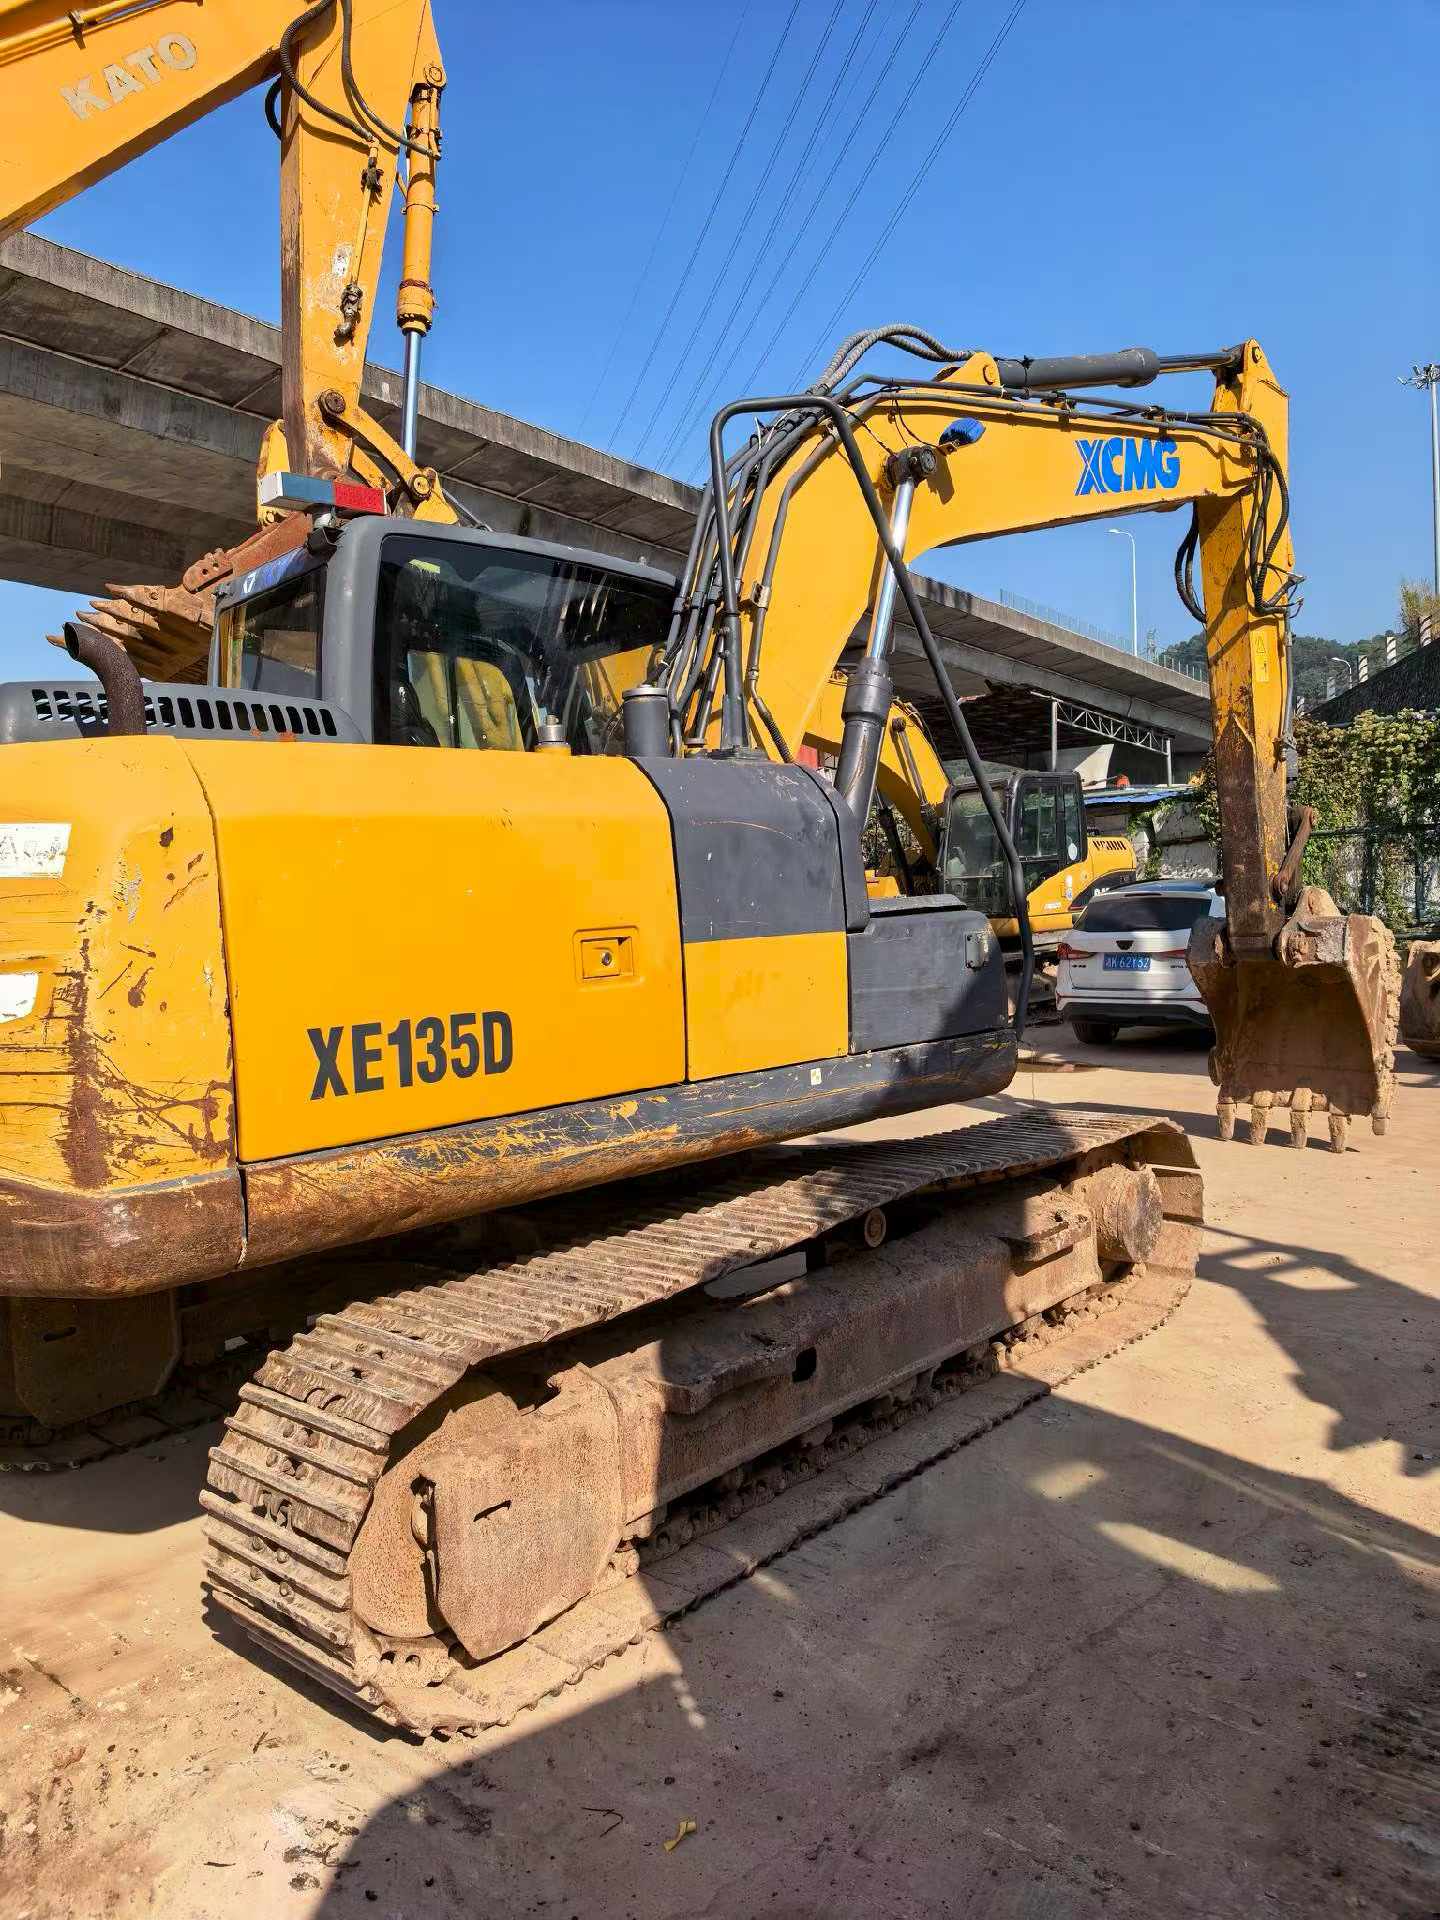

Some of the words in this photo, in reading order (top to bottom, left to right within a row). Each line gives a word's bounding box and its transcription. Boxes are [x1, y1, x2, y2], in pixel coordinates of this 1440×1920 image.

[60, 32, 197, 120] KATO
[1074, 436, 1181, 496] XCMG
[306, 1010, 514, 1101] XE135D
